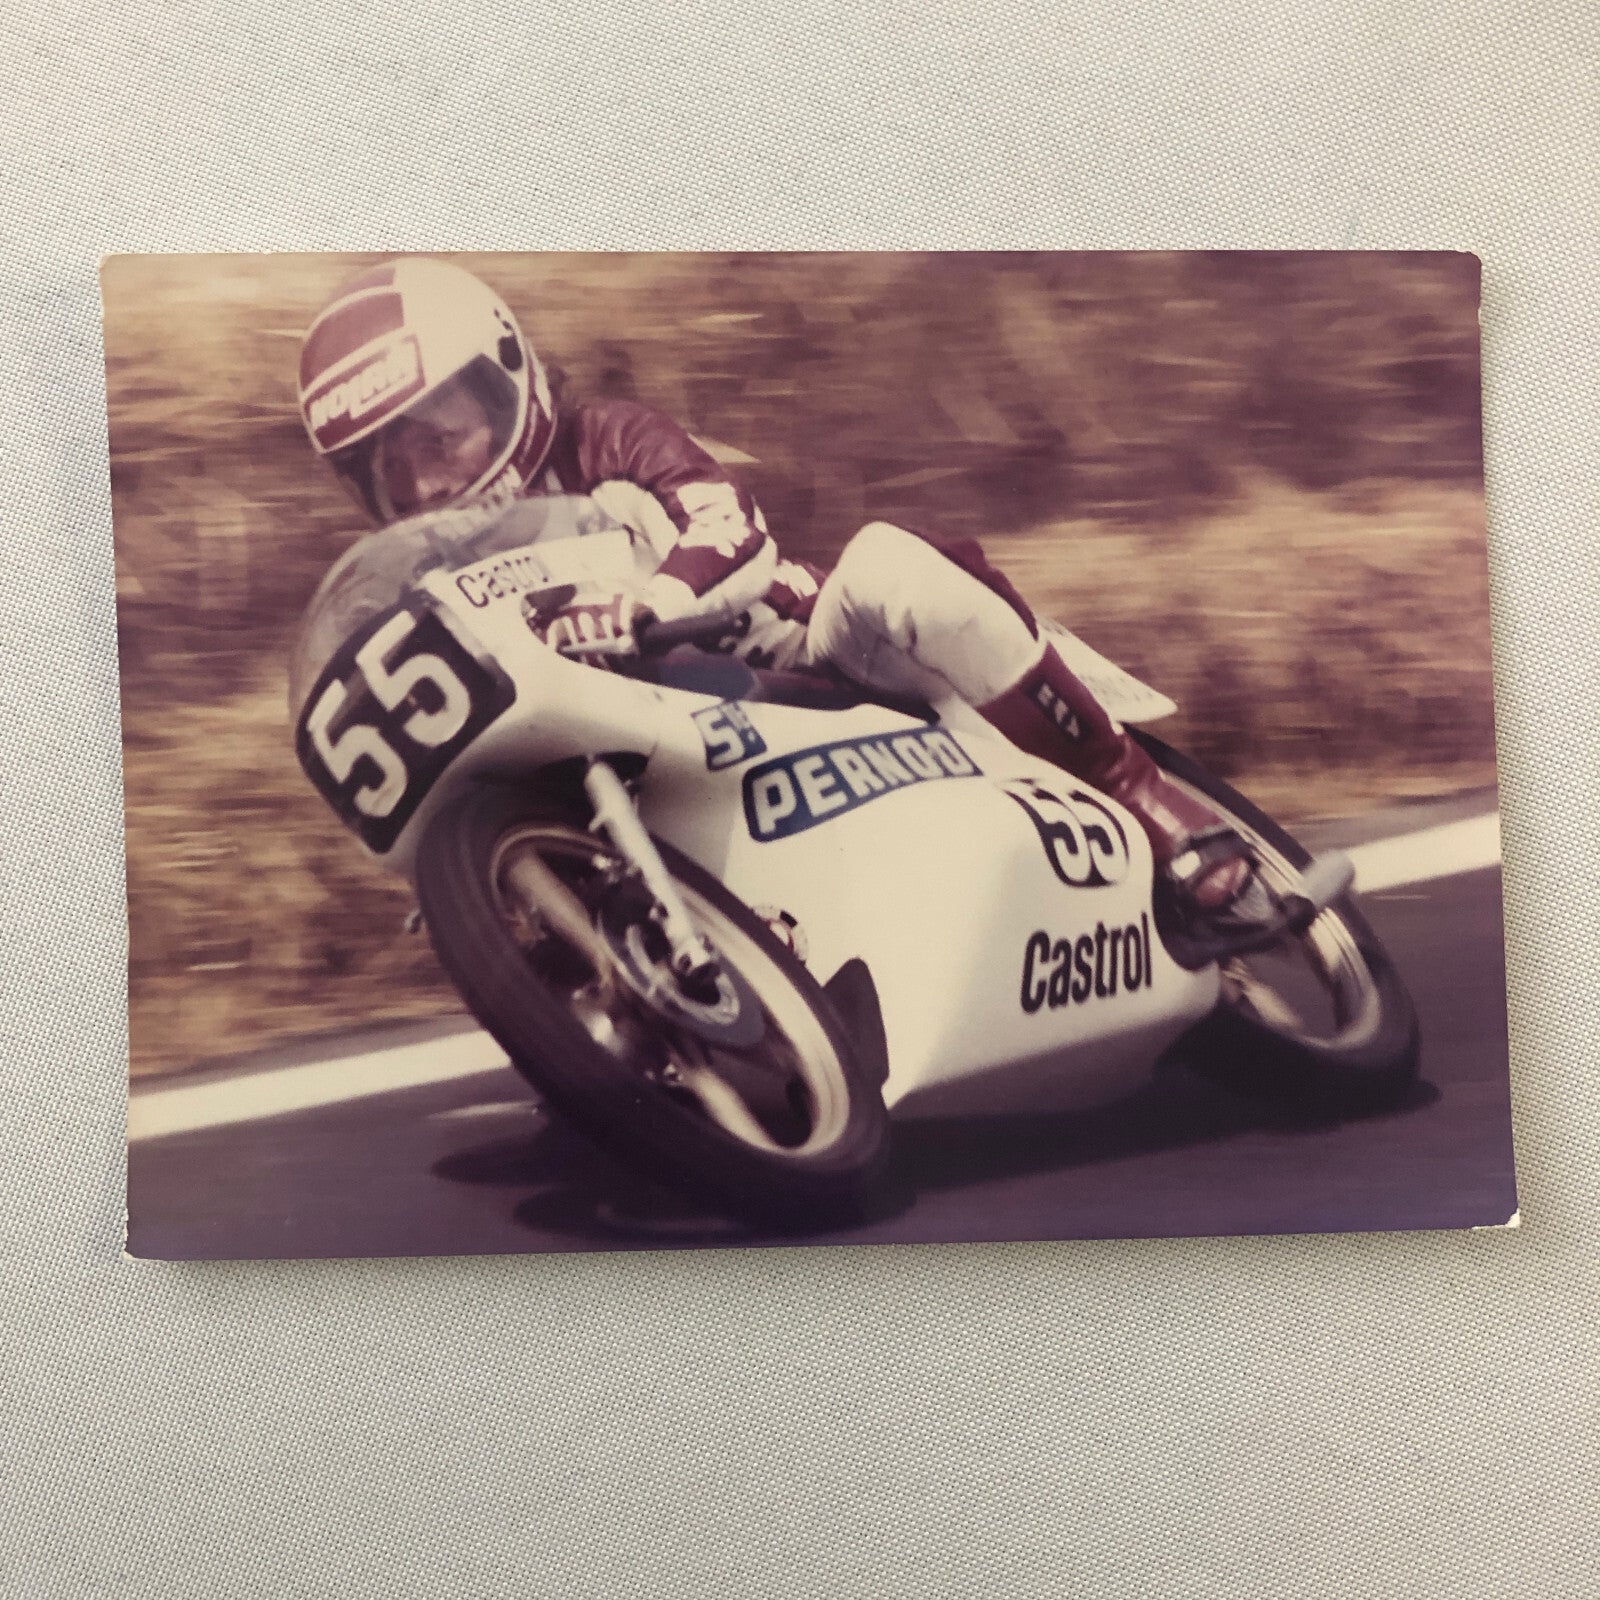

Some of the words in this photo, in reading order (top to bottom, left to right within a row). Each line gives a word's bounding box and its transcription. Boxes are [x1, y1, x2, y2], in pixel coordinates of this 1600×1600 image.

[306, 608, 472, 818] 55
[751, 730, 975, 835] PERNOD
[1003, 778, 1129, 887] 55
[1020, 911, 1152, 1015] Castrol
